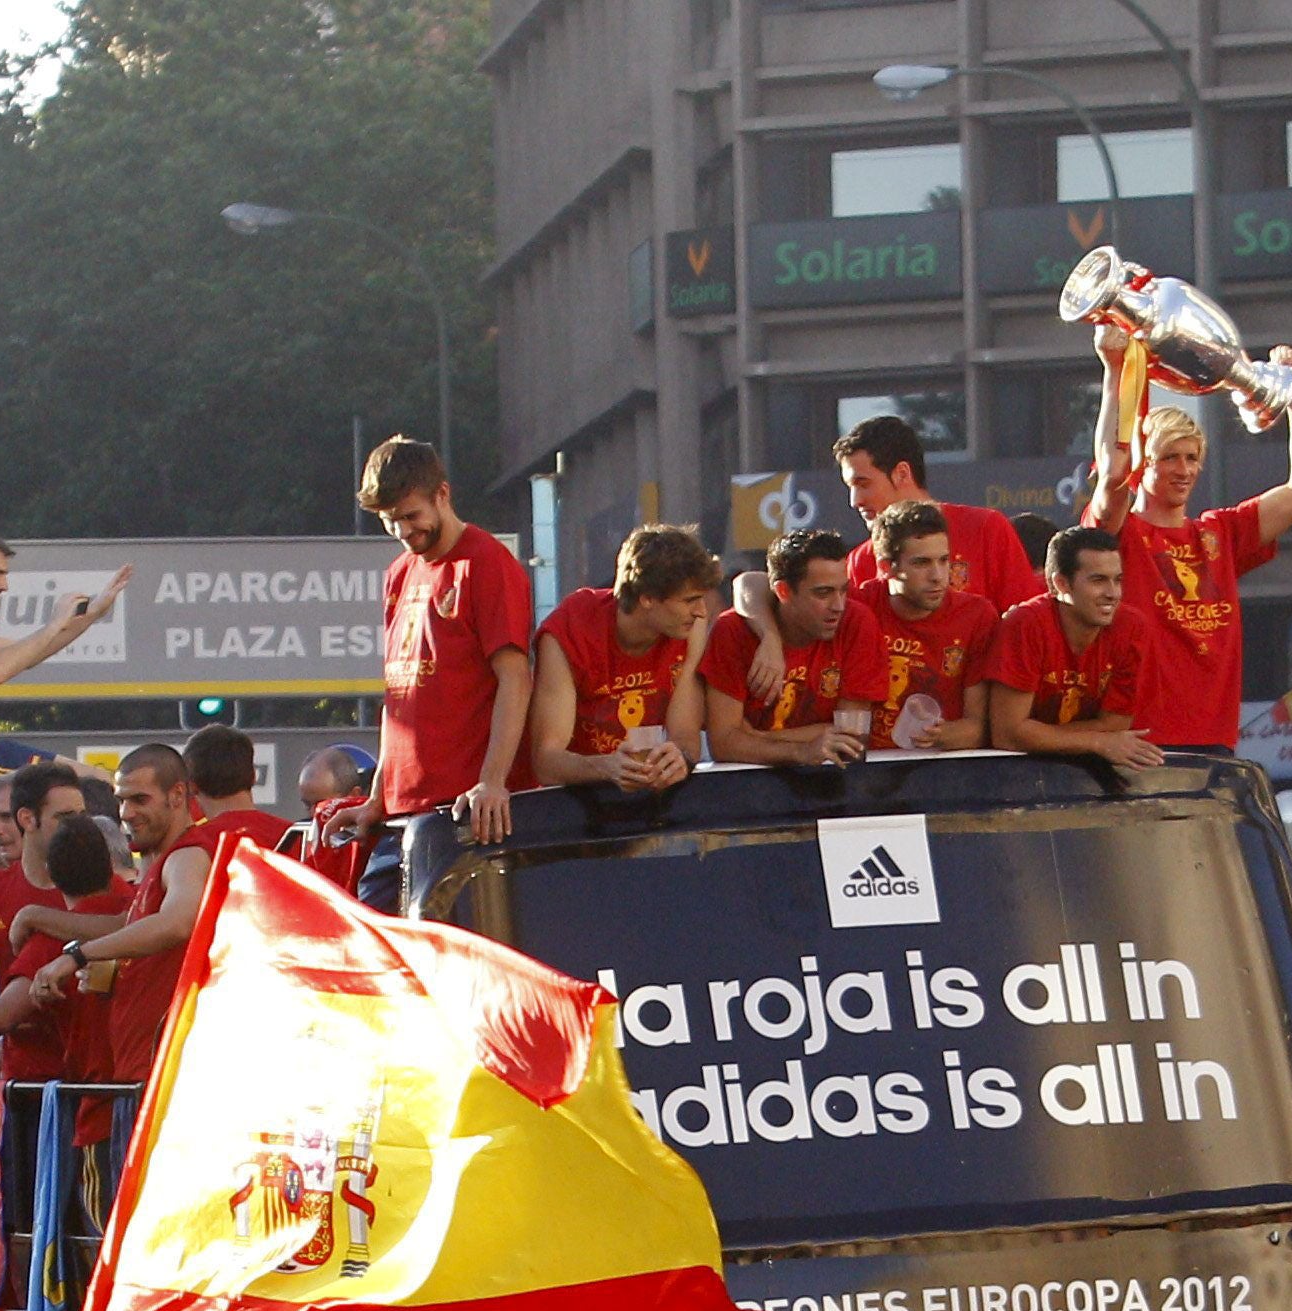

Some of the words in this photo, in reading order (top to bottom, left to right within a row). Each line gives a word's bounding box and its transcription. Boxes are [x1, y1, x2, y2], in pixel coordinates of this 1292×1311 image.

[774, 234, 939, 284] Solaria
[155, 570, 385, 603] APARCAMI
[166, 625, 306, 659] PLAZA
[615, 671, 655, 688] 2012
[842, 876, 919, 898] adidas
[710, 955, 892, 1056] roja
[905, 949, 986, 1030] is
[1002, 942, 1107, 1027] all
[1119, 941, 1201, 1021] in
[942, 1050, 1023, 1131] is
[1040, 1043, 1144, 1127] all
[1154, 1042, 1238, 1122] in
